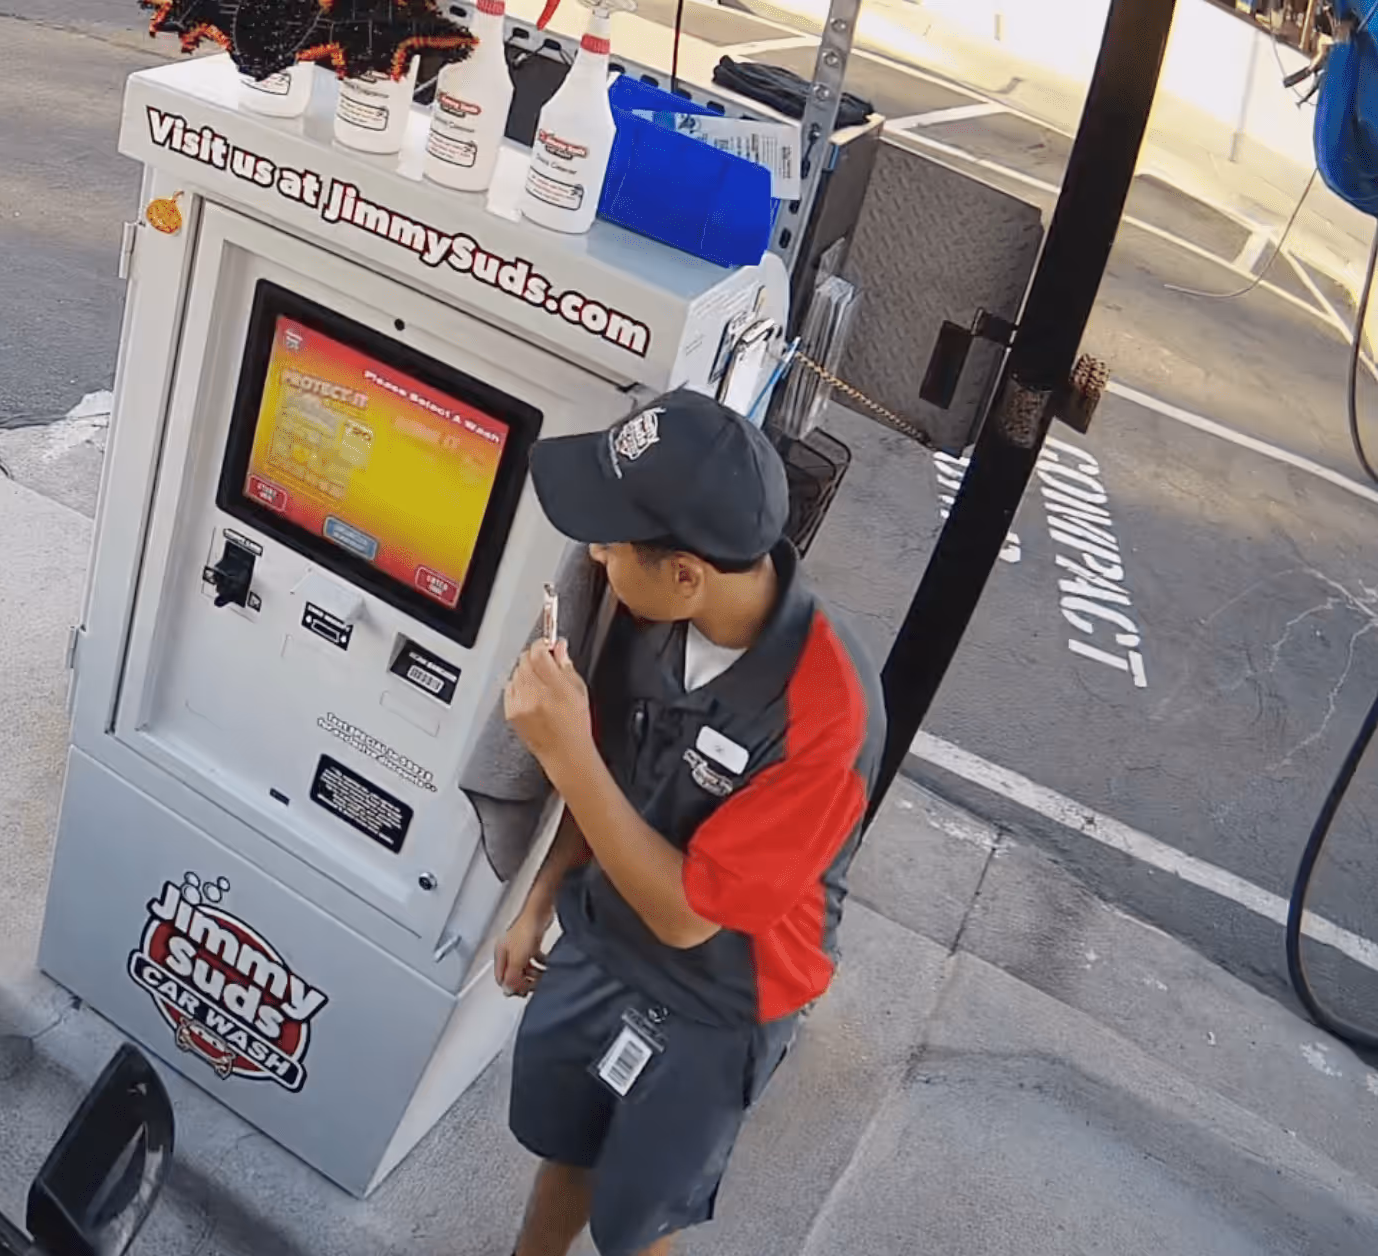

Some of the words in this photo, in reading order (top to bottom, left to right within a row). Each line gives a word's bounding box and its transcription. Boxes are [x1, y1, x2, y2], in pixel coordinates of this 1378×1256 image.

[147, 106, 229, 169] Visit
[231, 145, 275, 188] us
[278, 166, 321, 209] at
[322, 178, 650, 358] JimmySuds.com
[363, 370, 407, 397] Please
[409, 393, 451, 418] Select
[453, 414, 462, 424] A
[464, 420, 500, 444] Wash
[1036, 435, 1148, 688] COMPACT
[147, 880, 328, 1021] Jimmy
[165, 936, 285, 1039] Suds
[142, 966, 200, 1016] CAR
[206, 1008, 291, 1076] WASH
